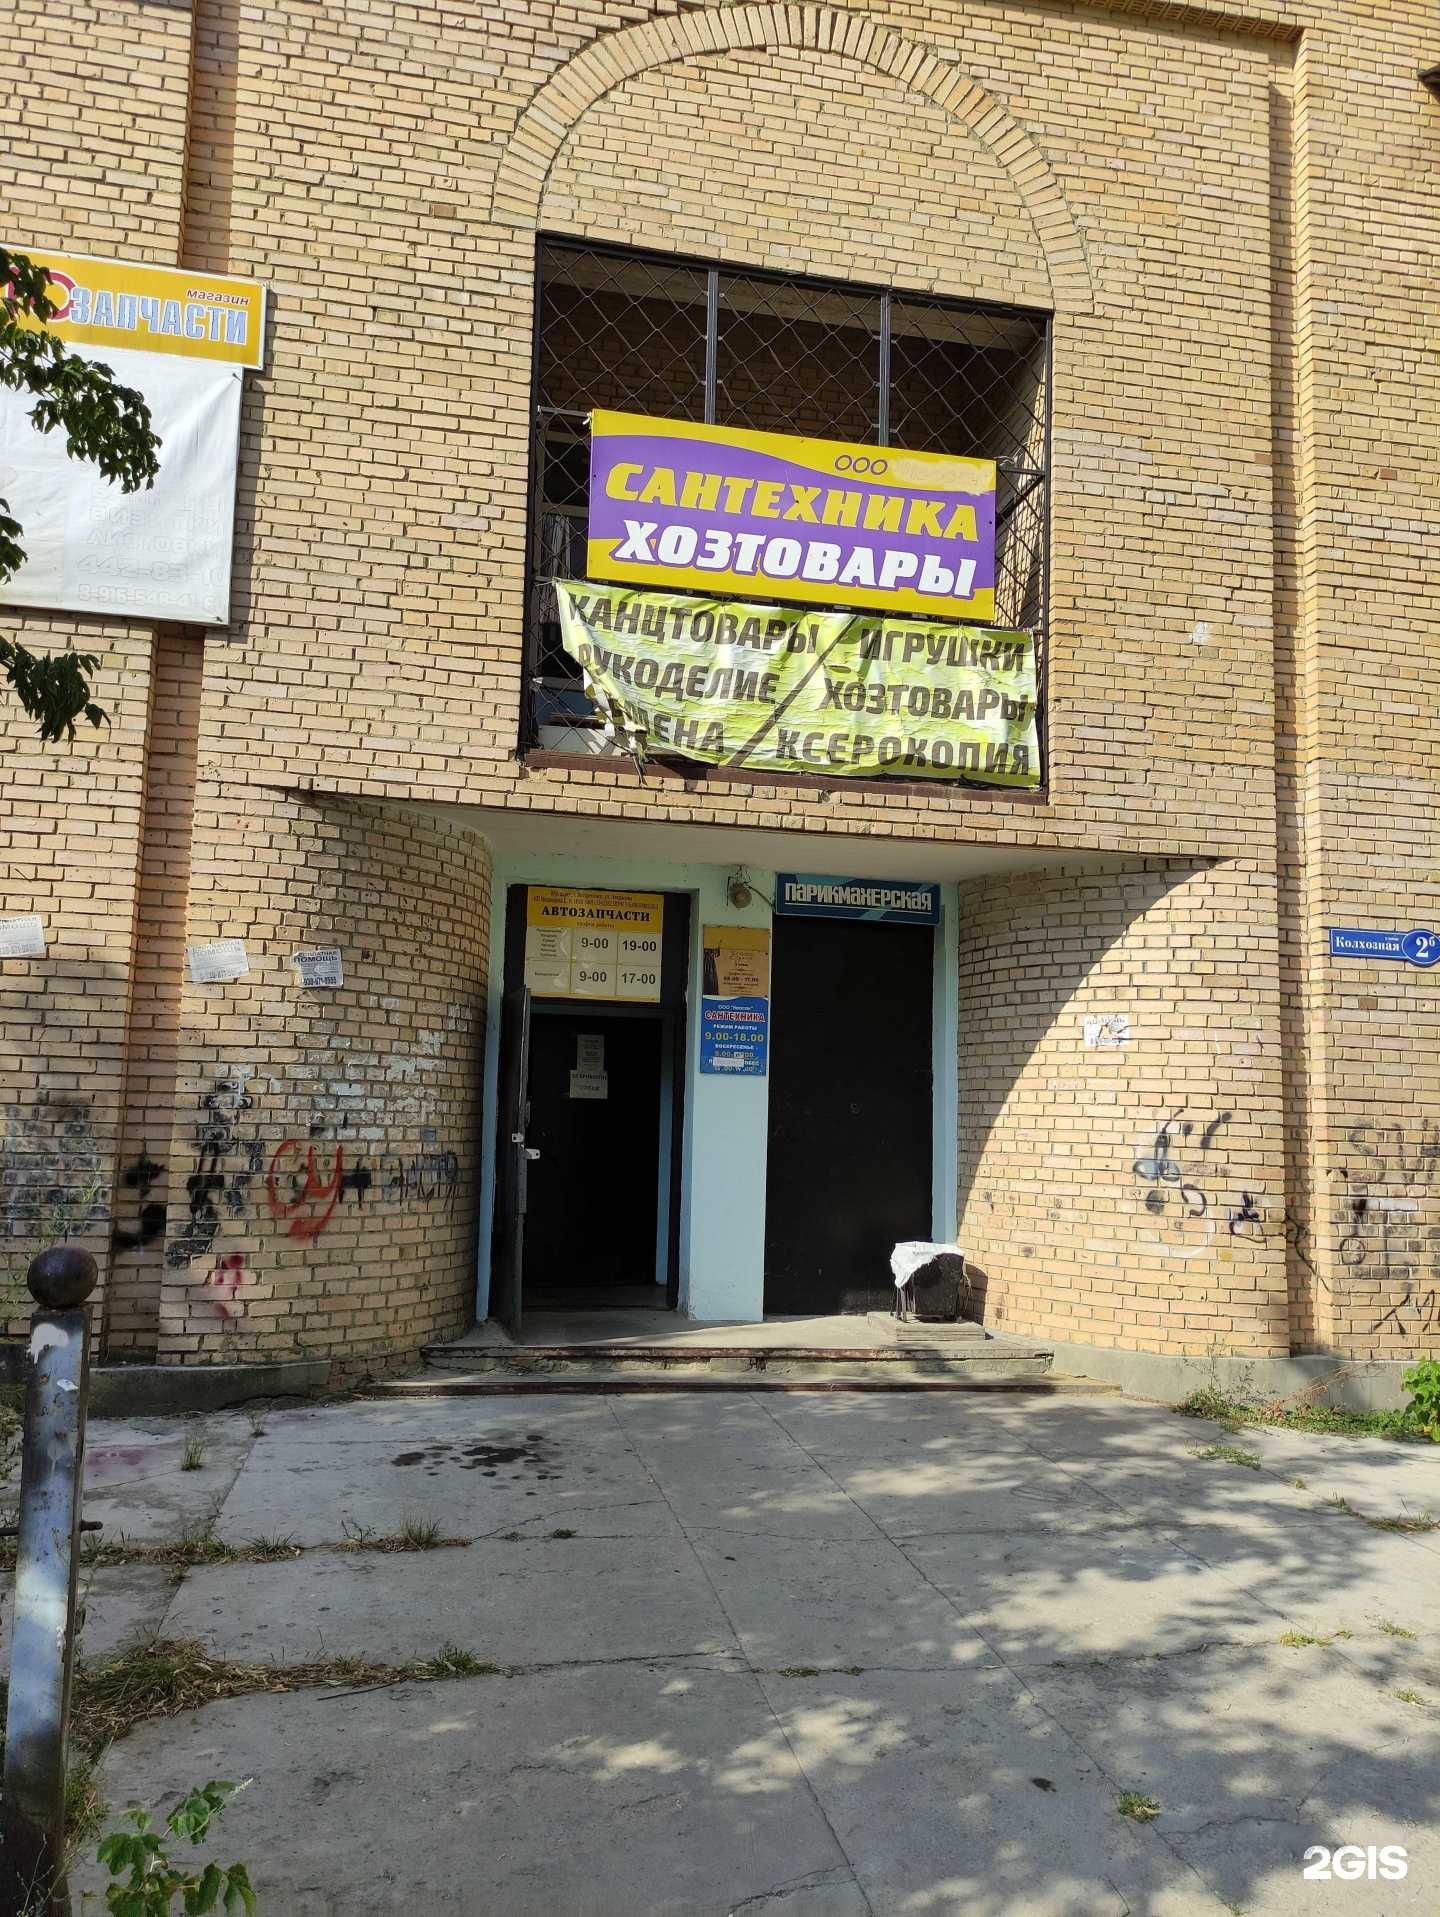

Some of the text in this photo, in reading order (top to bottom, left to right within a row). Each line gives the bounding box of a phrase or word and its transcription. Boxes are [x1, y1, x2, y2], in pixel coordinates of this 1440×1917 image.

[187, 288, 249, 305] магазин
[834, 454, 888, 475] ООО
[604, 462, 979, 543] САНТЕХНИКА
[612, 518, 978, 600] ХОЗТОВАРЫ
[568, 592, 1026, 673] КАНЦТОВАРЫ ИГРУШКИ
[577, 643, 1029, 723] РУКОДЕЛИЕ ХОЗТОВАРЫ
[775, 727, 1030, 777] КСЕРОКОПИЯ
[541, 904, 650, 922] АВТОЗАПЧАСТИ
[581, 937, 609, 949] 9-00
[622, 940, 657, 952] 19-00
[1335, 936, 1400, 952] Колхозная
[579, 971, 607, 983] 9-00
[621, 973, 656, 985] 17-00
[704, 1010, 766, 1022] САНТЕХНИКА
[704, 1031, 764, 1042] 9.00-18.00
